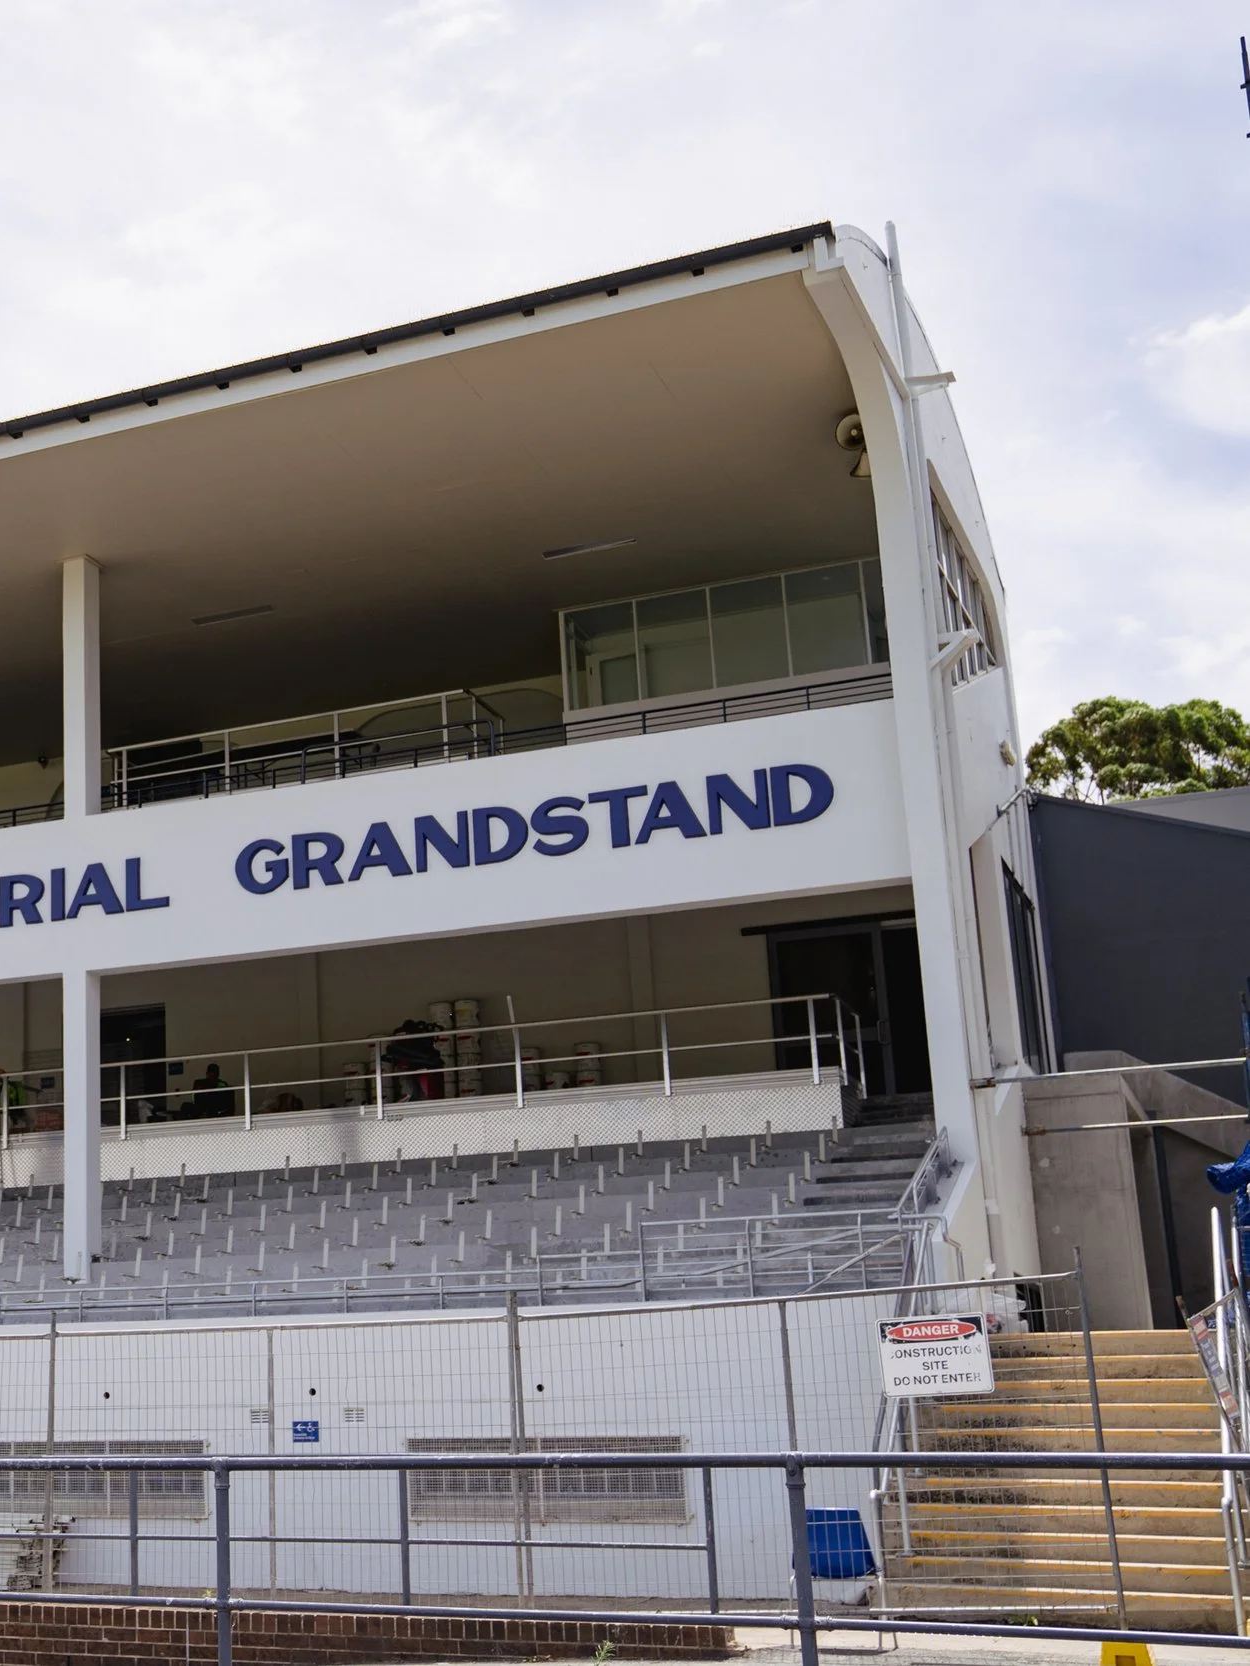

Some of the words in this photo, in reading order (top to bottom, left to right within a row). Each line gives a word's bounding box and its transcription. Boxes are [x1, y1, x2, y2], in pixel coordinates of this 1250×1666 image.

[234, 763, 835, 894] GRANDSTAND
[902, 1324, 959, 1337] DANGER
[922, 1361, 949, 1371] SITE
[893, 1376, 910, 1387] DO
[913, 1375, 938, 1385] NOT
